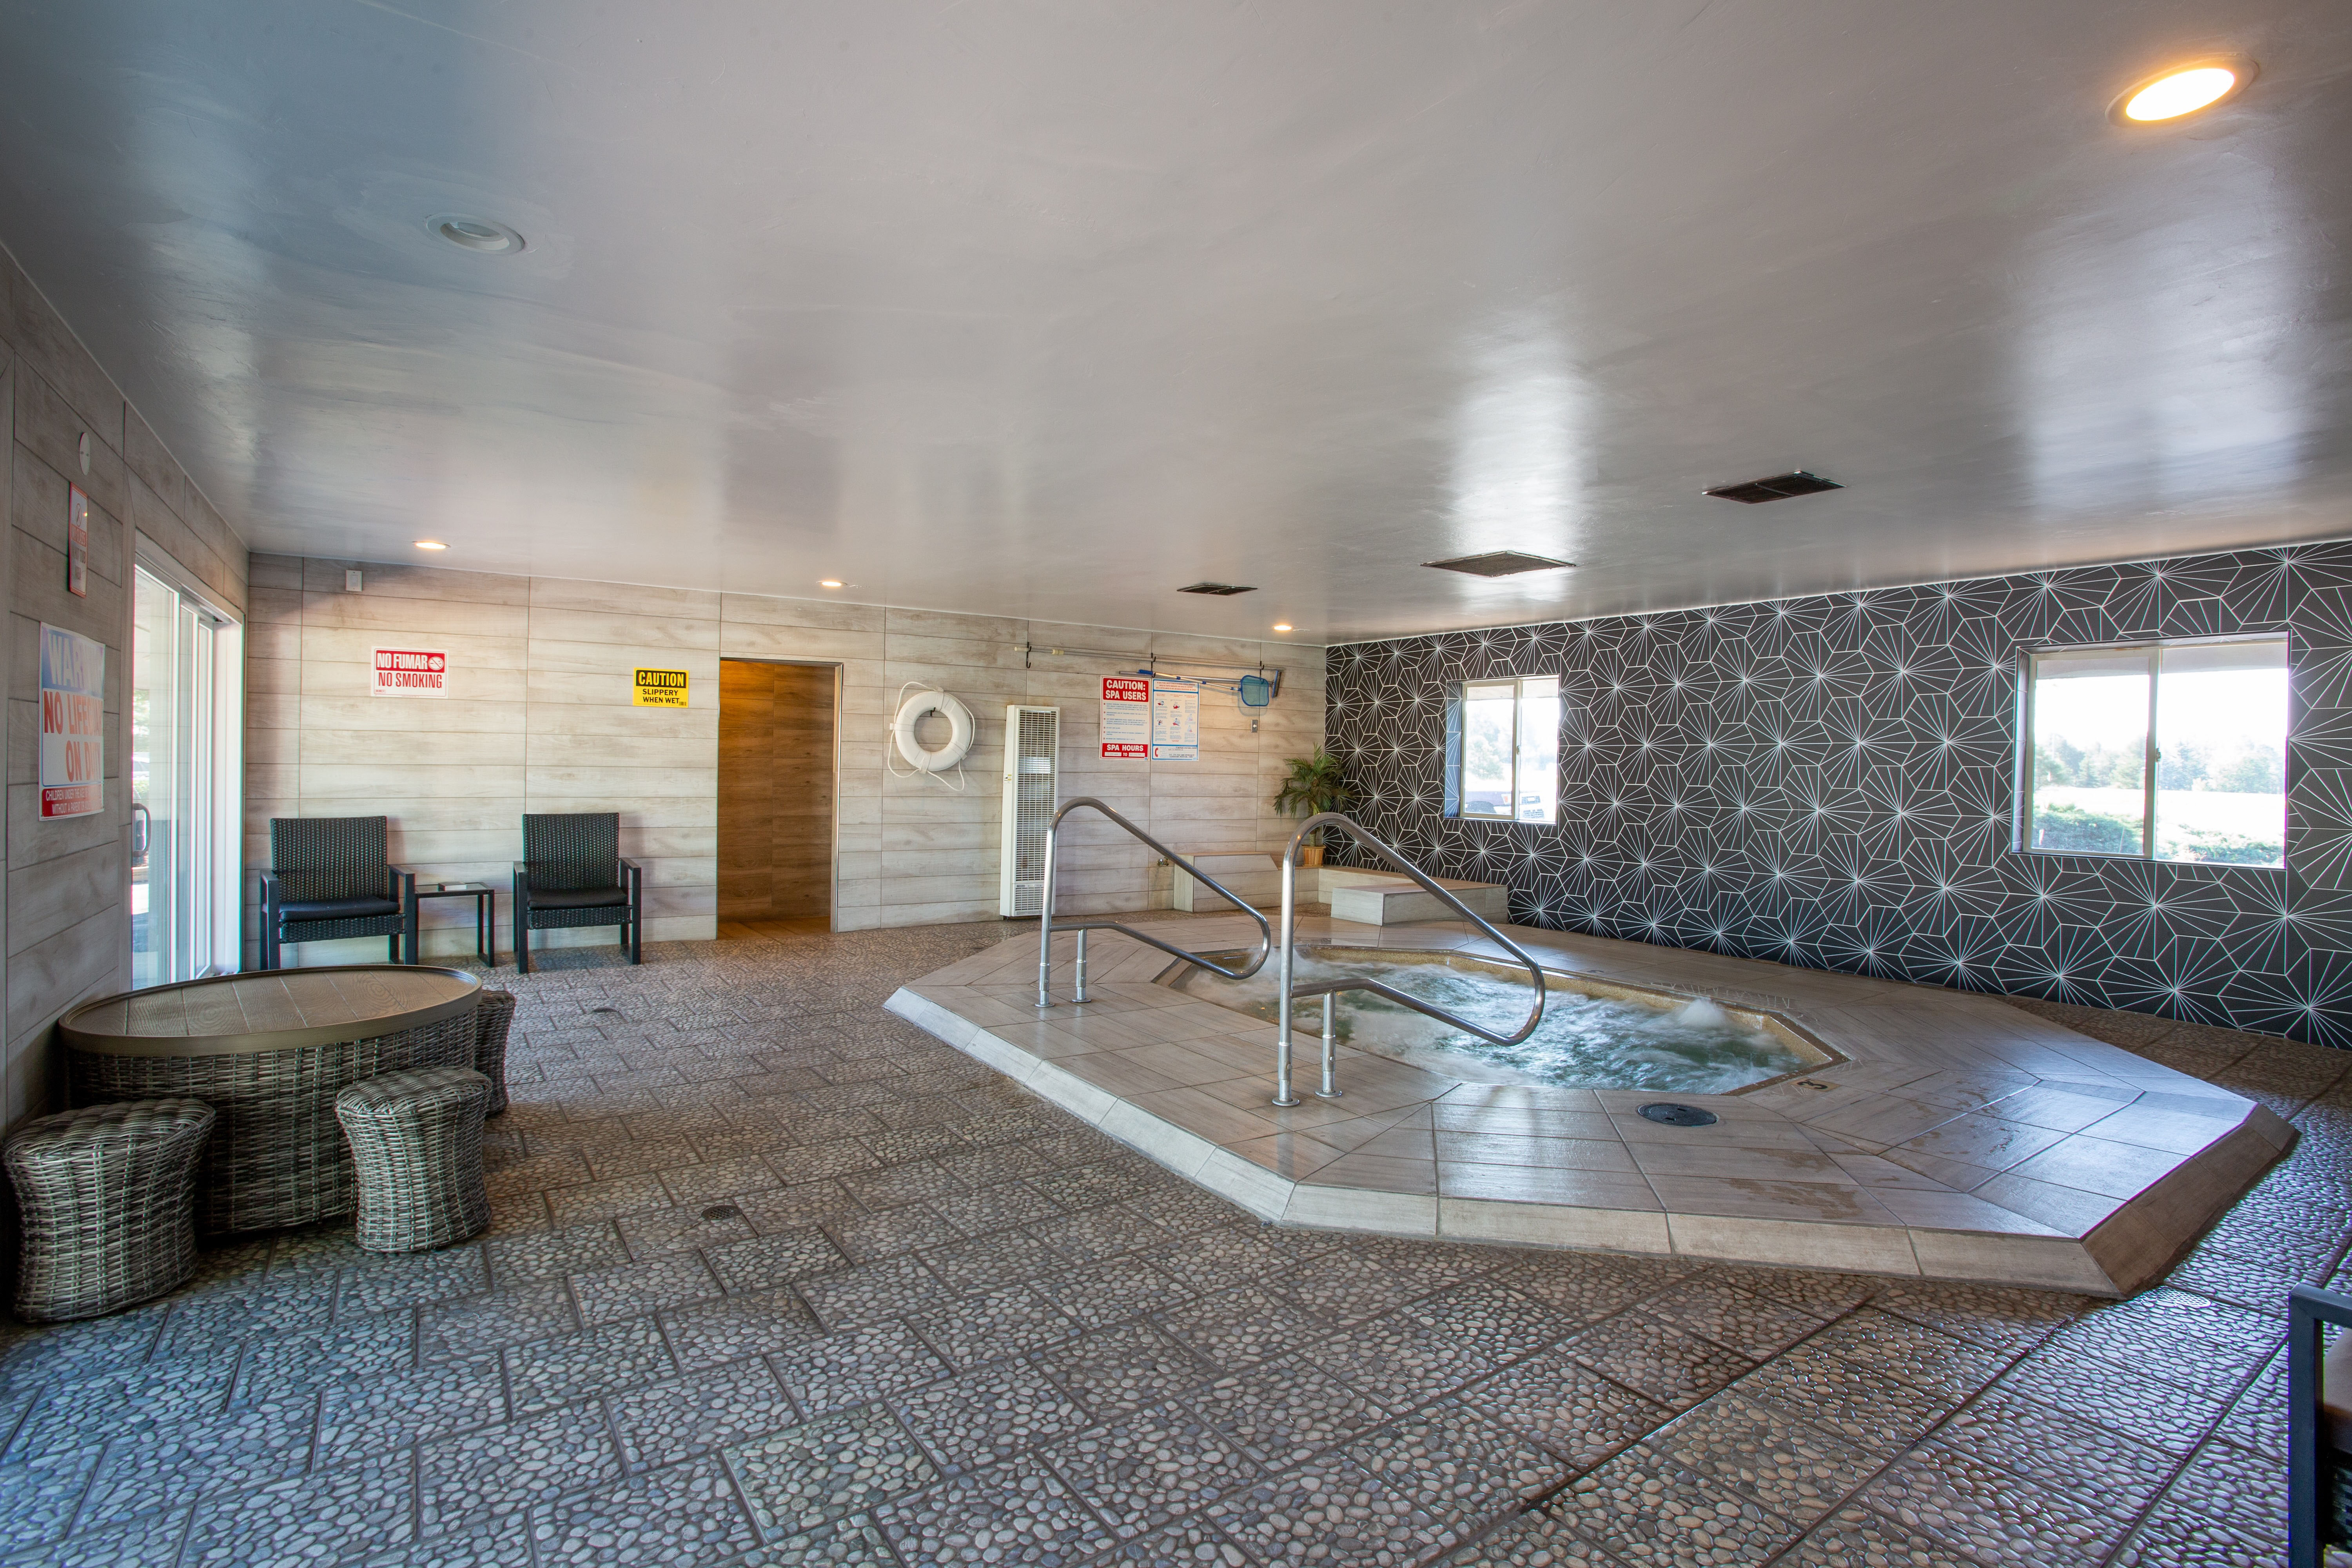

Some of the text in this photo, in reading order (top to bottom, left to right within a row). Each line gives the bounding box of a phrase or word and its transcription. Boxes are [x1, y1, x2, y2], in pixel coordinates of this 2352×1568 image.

[76, 529, 85, 545] GLASS
[48, 633, 101, 694] WARN
[377, 653, 428, 670] NO FUMAR
[378, 672, 442, 688] NO SMOKING
[638, 671, 684, 686] CAUTION
[1106, 679, 1145, 691] CAUTION:
[1105, 690, 1146, 701] SPA USERS
[44, 691, 102, 736] NO LIFEGUA
[66, 740, 101, 782] ON DUTY
[46, 789, 64, 801] CHILDREN
[65, 789, 74, 799] UNDER
[52, 803, 67, 814] WITHOUT
[68, 802, 71, 813] A
